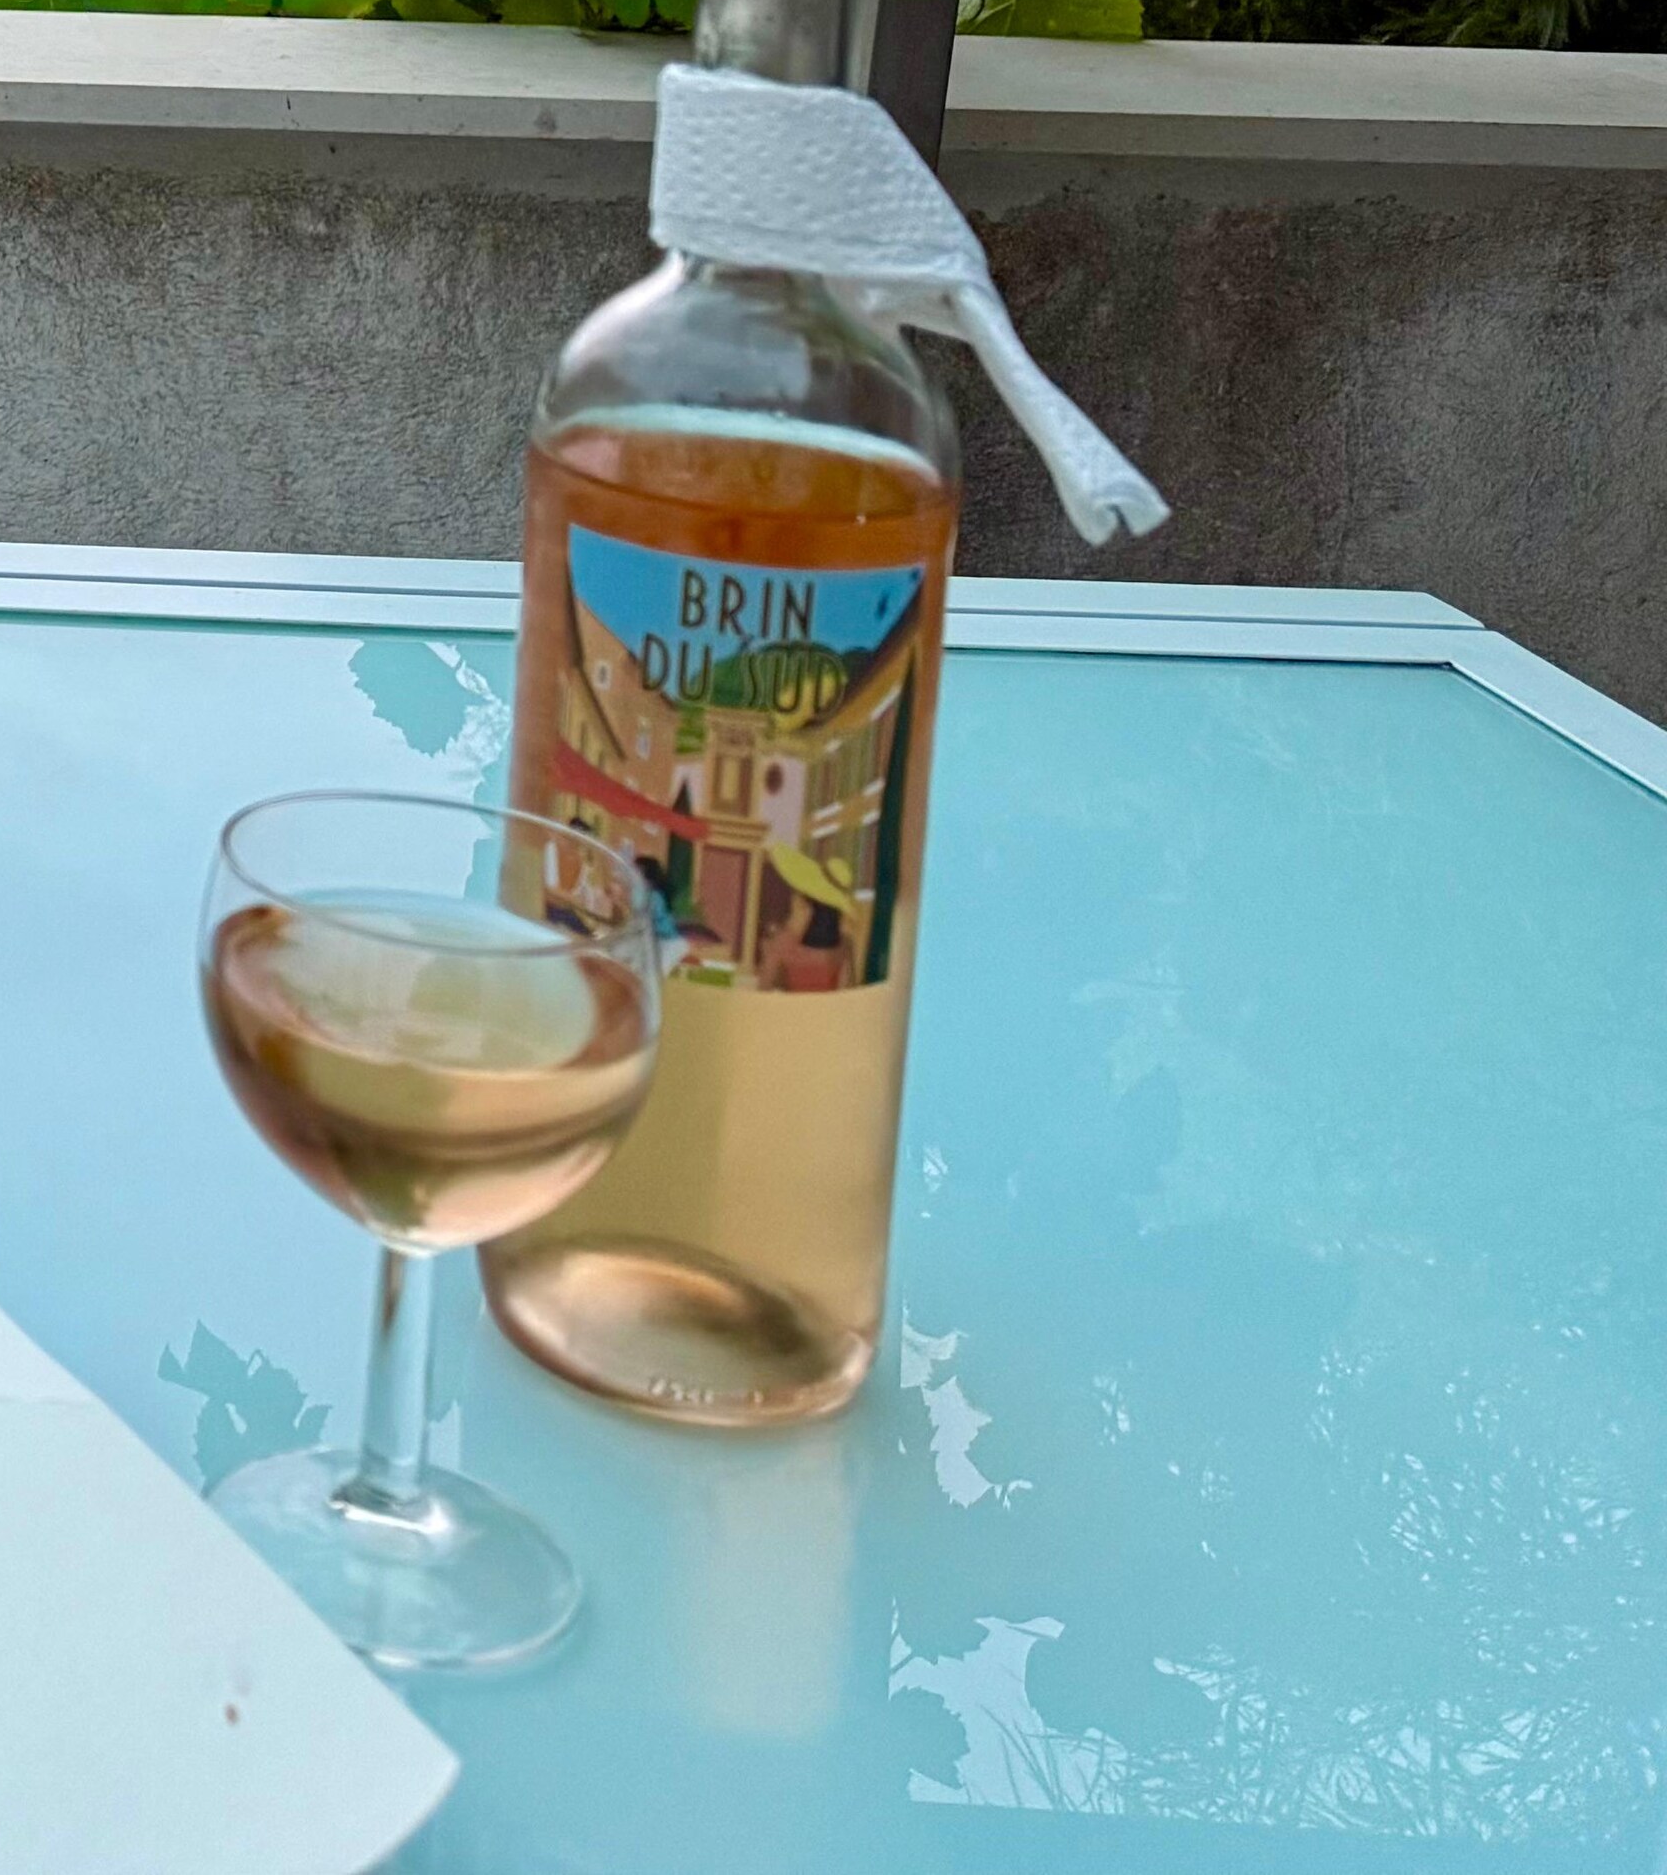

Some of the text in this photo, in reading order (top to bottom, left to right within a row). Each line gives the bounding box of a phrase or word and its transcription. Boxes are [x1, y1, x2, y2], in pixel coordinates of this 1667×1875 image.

[679, 568, 815, 640] BRIN
[641, 632, 845, 717] DU SUD
